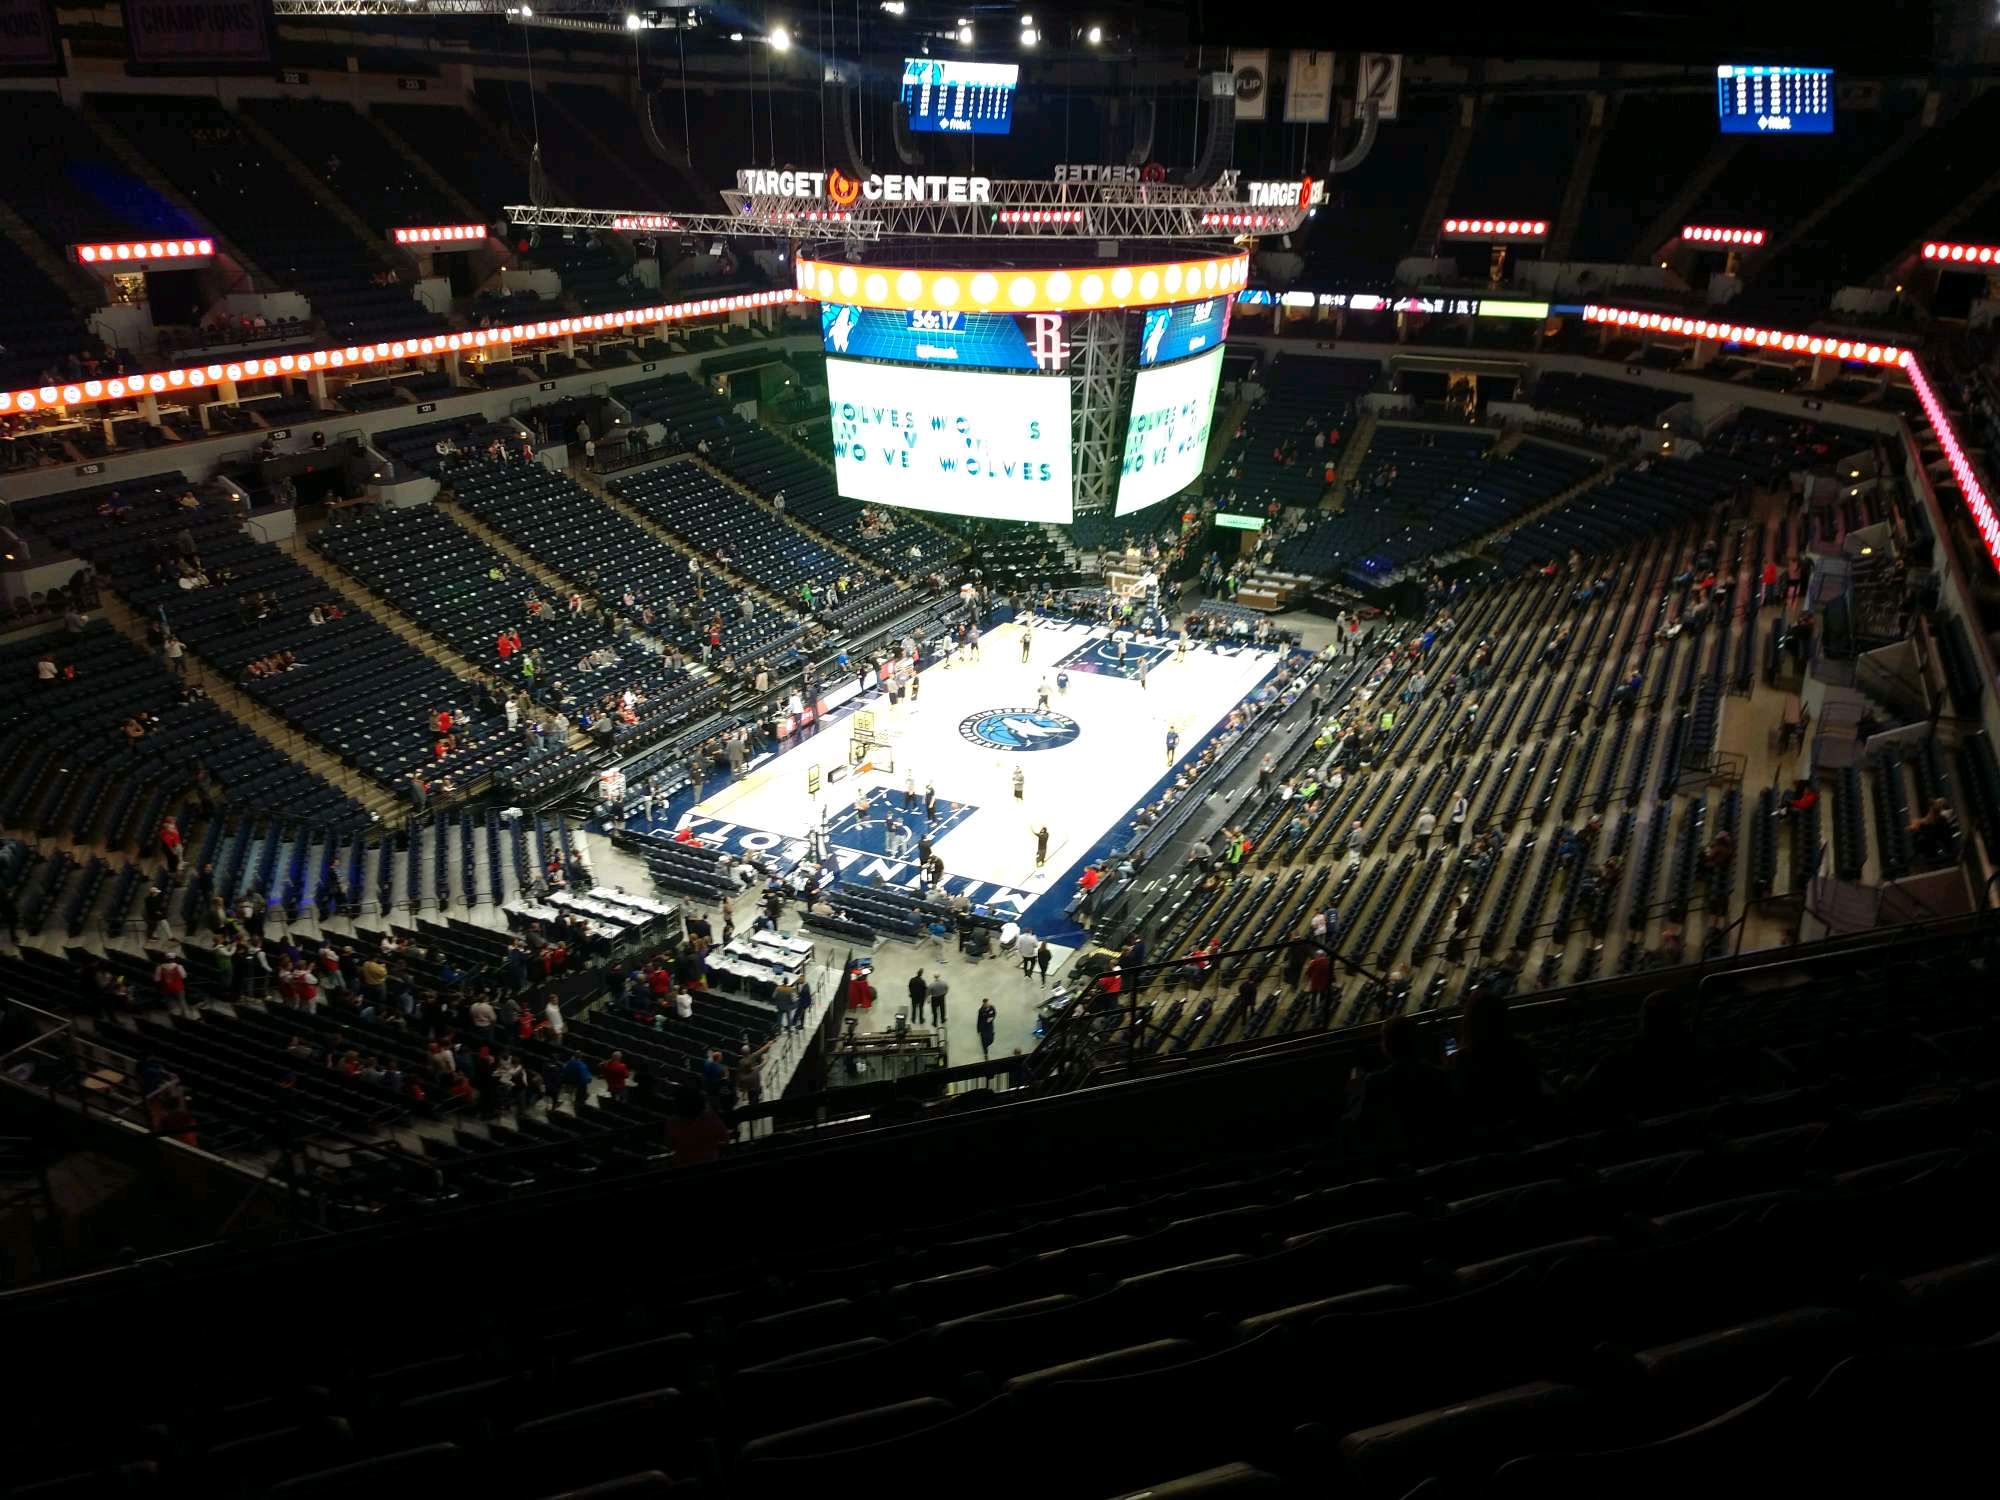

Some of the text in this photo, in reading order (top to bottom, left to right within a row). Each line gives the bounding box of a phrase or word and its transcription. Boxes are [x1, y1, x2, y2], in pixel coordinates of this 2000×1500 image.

[142, 3, 257, 33] CHAMPIONS
[1236, 79, 1261, 90] FLIP
[1368, 56, 1393, 98] 2
[745, 169, 990, 203] TARGET CENTER
[1248, 181, 1302, 207] TARGET
[912, 310, 958, 330] 56:17
[939, 456, 1051, 481] WOLVES
